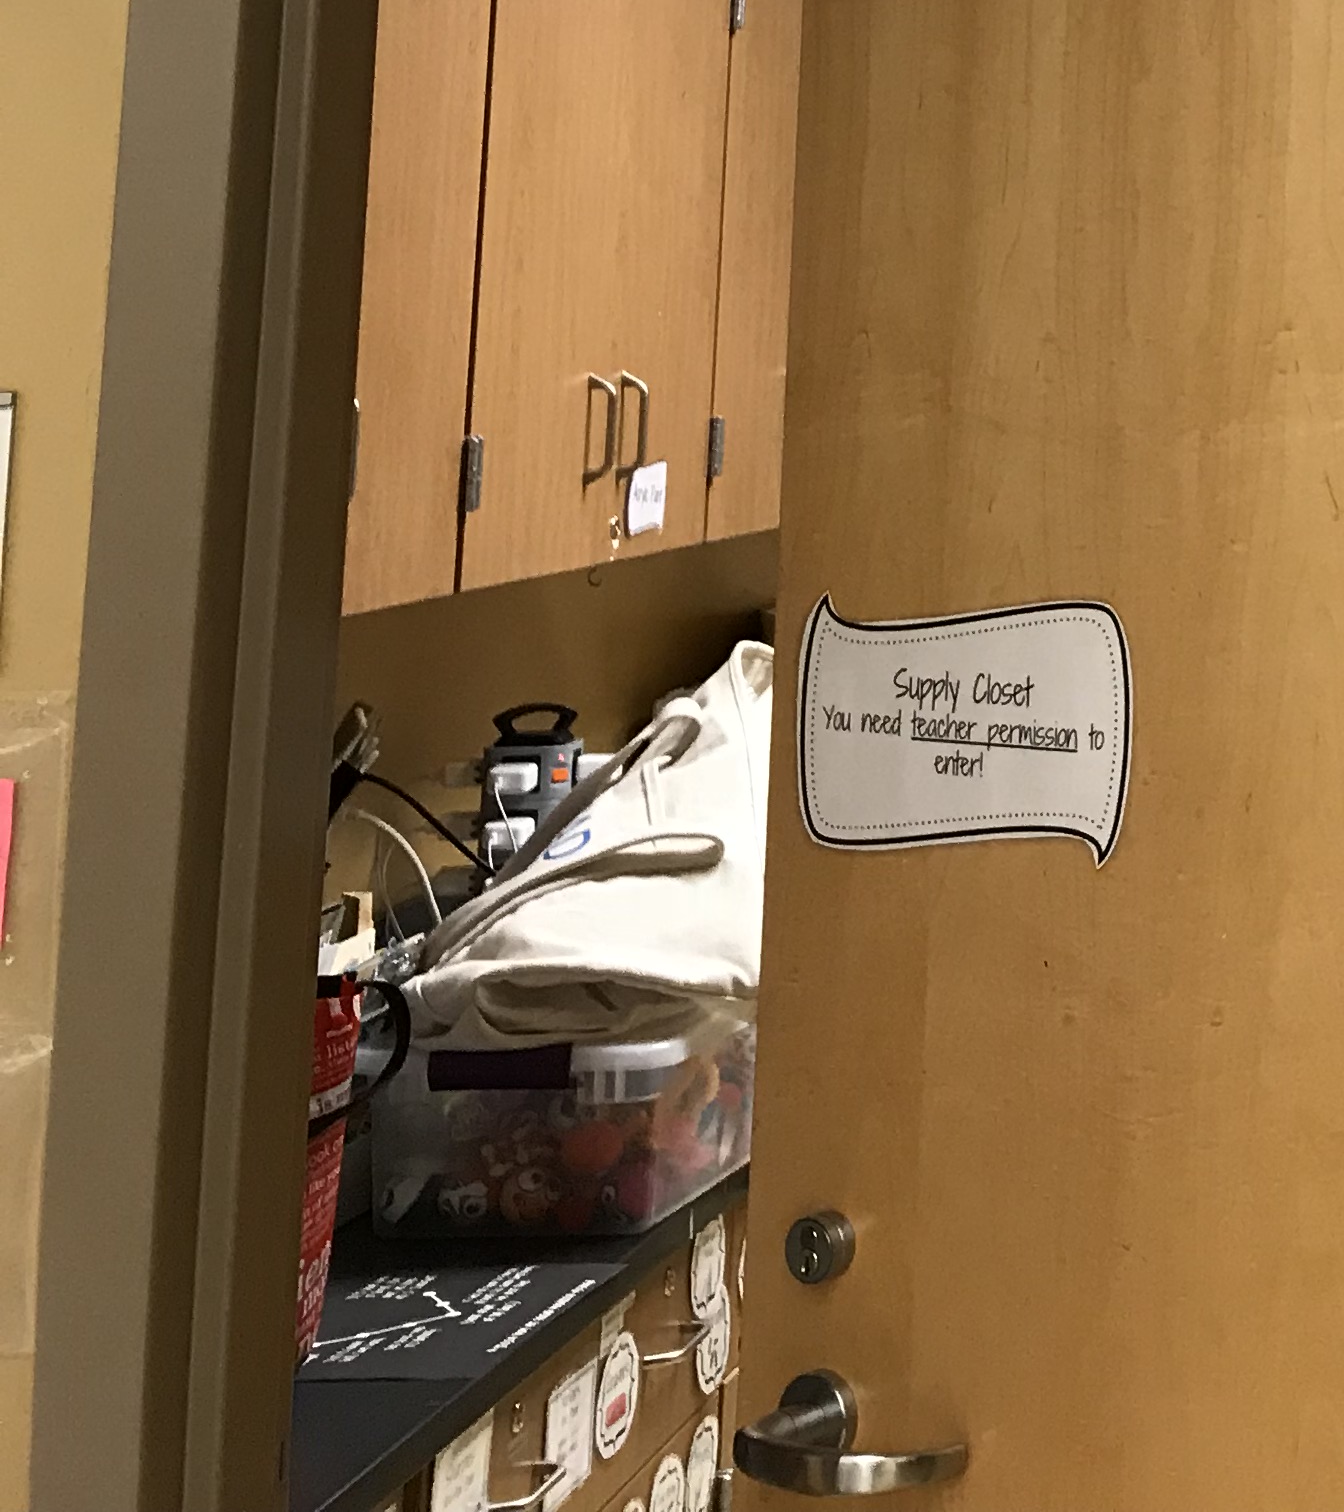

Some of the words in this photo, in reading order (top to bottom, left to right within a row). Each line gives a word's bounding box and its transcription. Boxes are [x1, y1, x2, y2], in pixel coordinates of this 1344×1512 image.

[893, 667, 960, 712] Supply
[973, 673, 1035, 707] Closet
[823, 705, 851, 732] You
[861, 711, 901, 734] need
[911, 709, 977, 741] teacher
[988, 723, 1078, 751] permission
[1088, 723, 1104, 750] to
[934, 751, 984, 777] enter!
